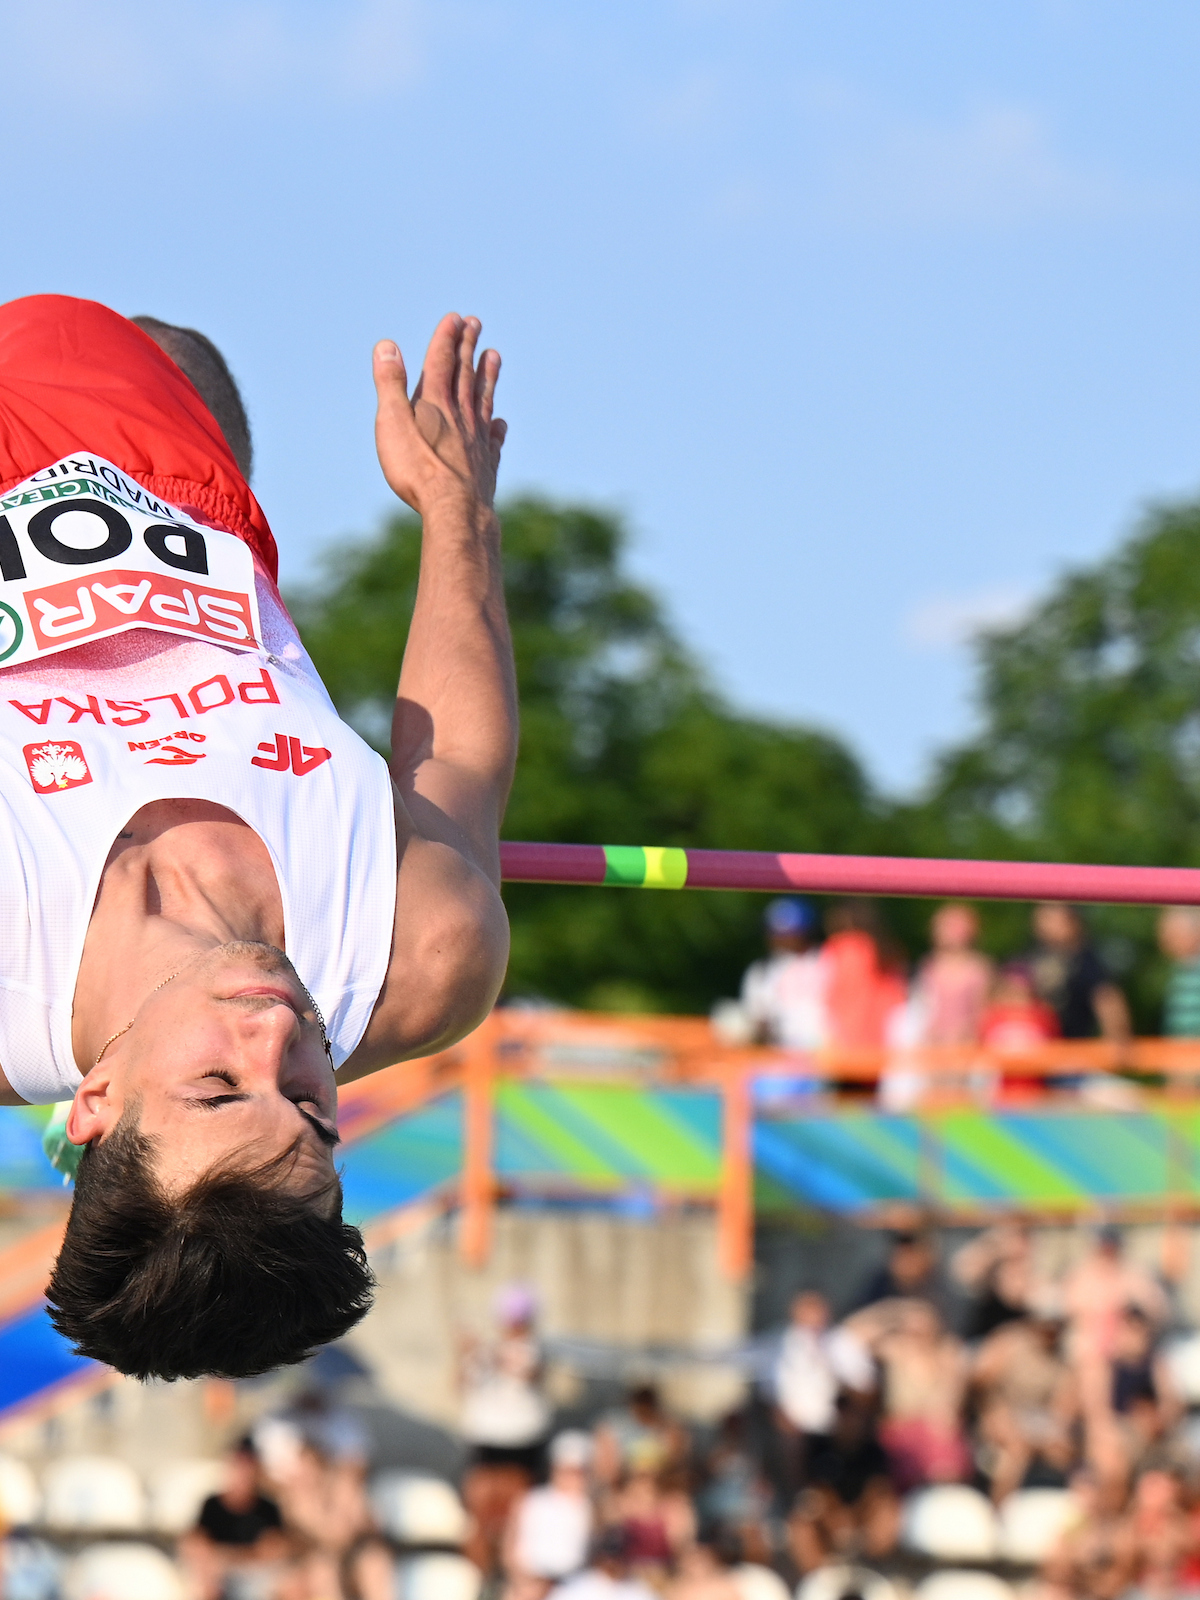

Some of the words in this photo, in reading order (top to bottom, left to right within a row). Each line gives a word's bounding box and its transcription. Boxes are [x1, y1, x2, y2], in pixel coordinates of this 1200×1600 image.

[33, 579, 250, 639] SPAR
[7, 667, 281, 727] POLSKA
[127, 730, 207, 752] ORLEN
